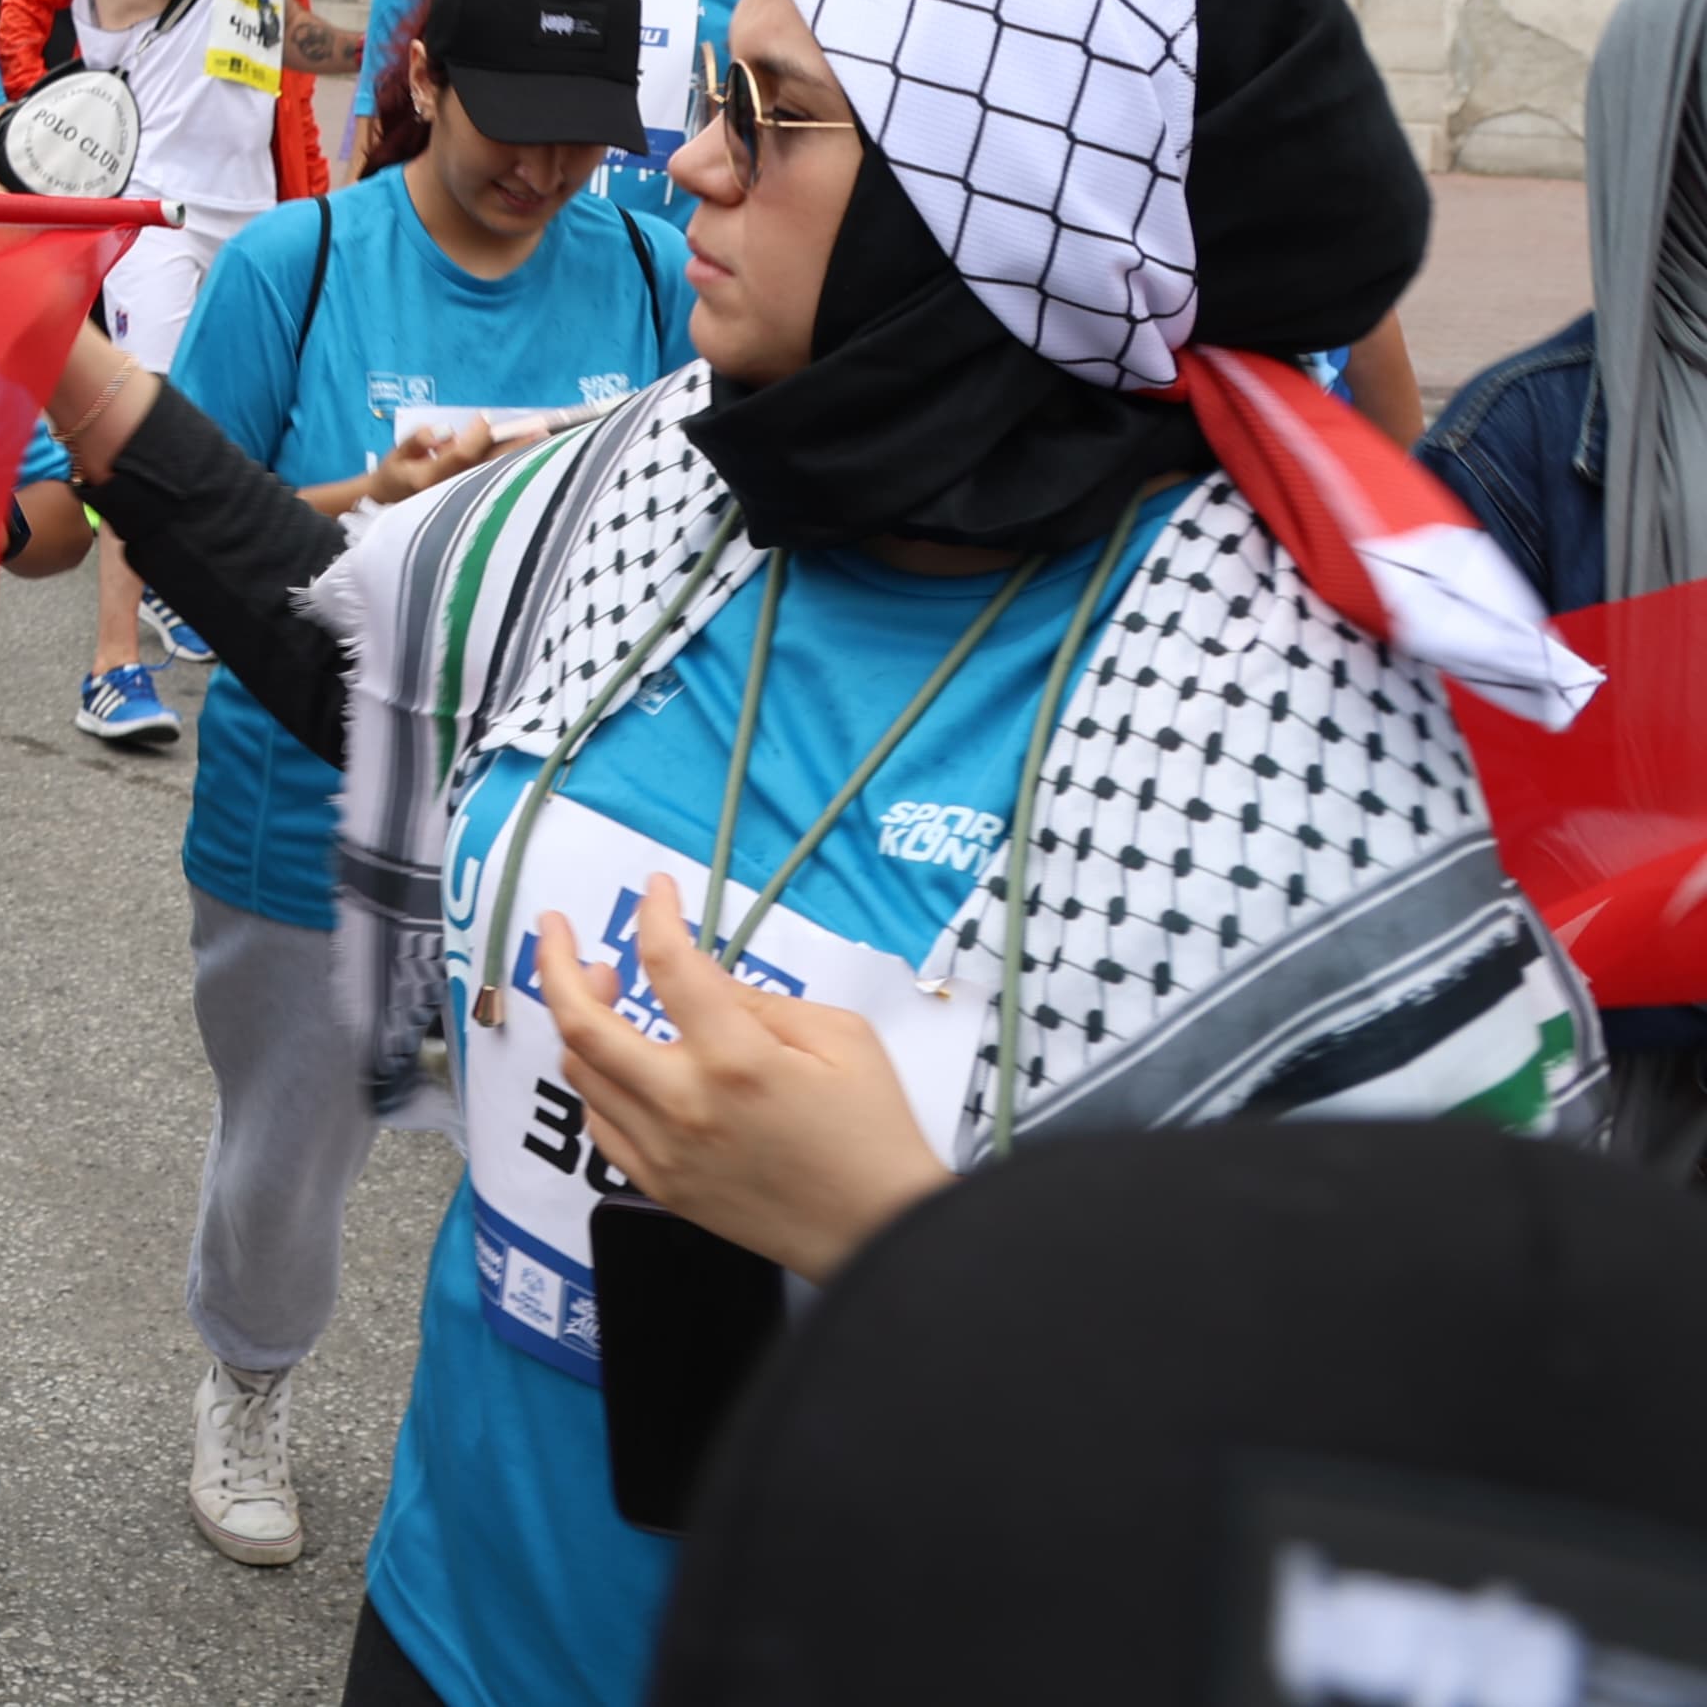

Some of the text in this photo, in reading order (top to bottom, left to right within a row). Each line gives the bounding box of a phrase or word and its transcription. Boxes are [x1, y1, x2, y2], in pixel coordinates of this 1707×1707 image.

[32, 108, 122, 176] POLO CLUB
[879, 800, 1006, 847] SPOR
